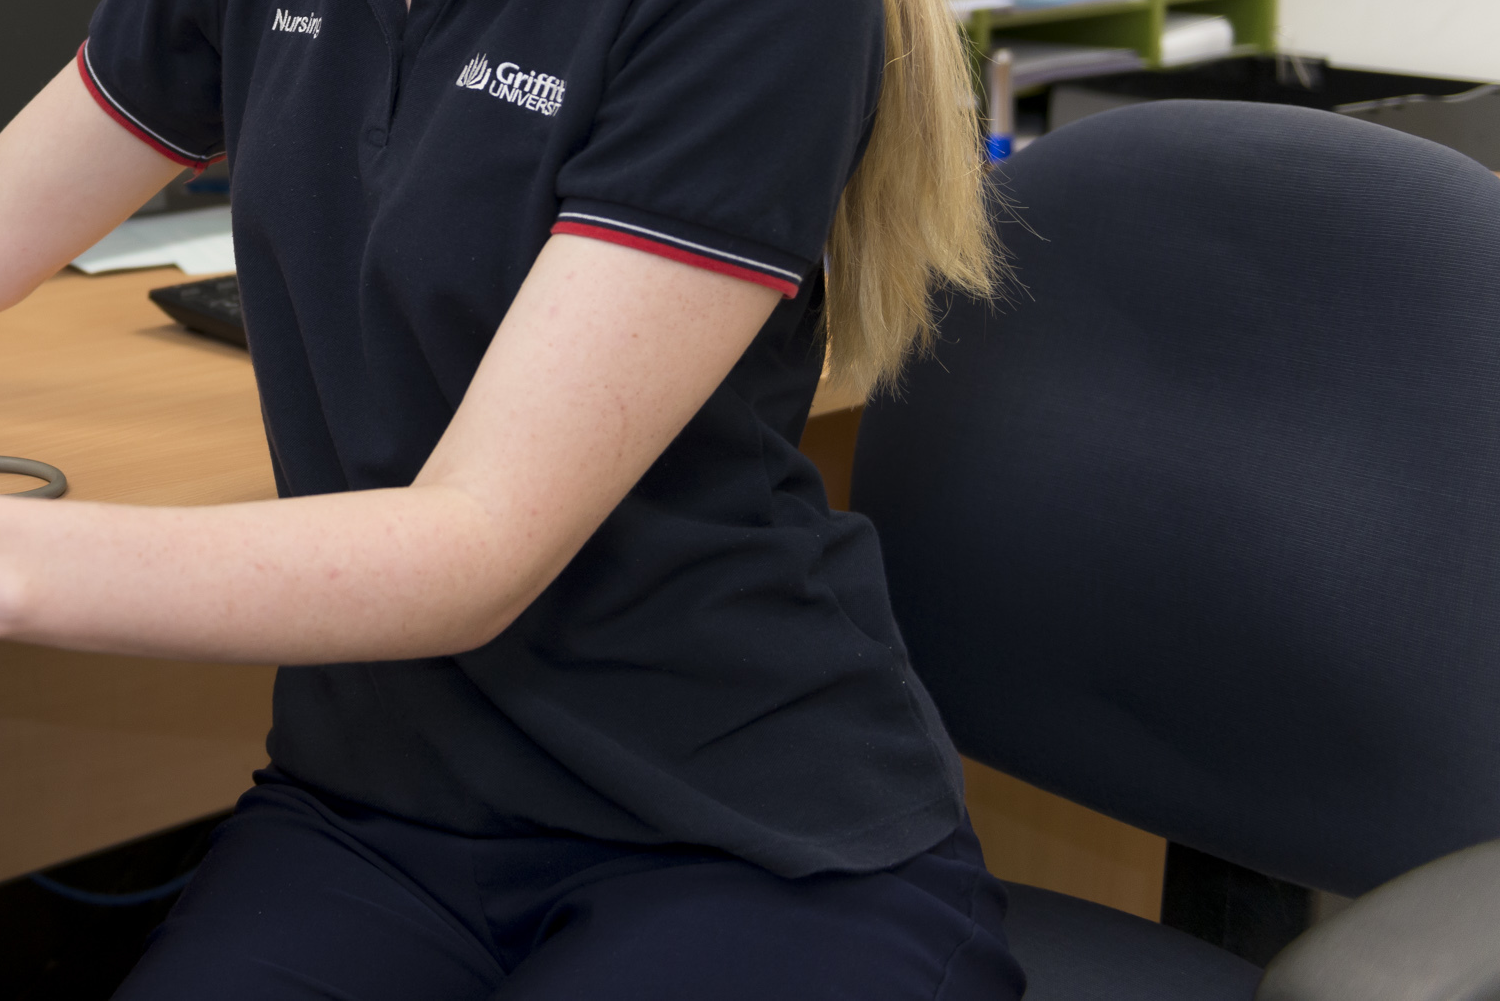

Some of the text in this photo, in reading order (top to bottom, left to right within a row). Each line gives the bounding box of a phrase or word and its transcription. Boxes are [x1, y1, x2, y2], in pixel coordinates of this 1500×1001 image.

[271, 8, 322, 39] Nursing
[488, 79, 562, 117] UNIVERSIT
[496, 61, 566, 103] Griffit
